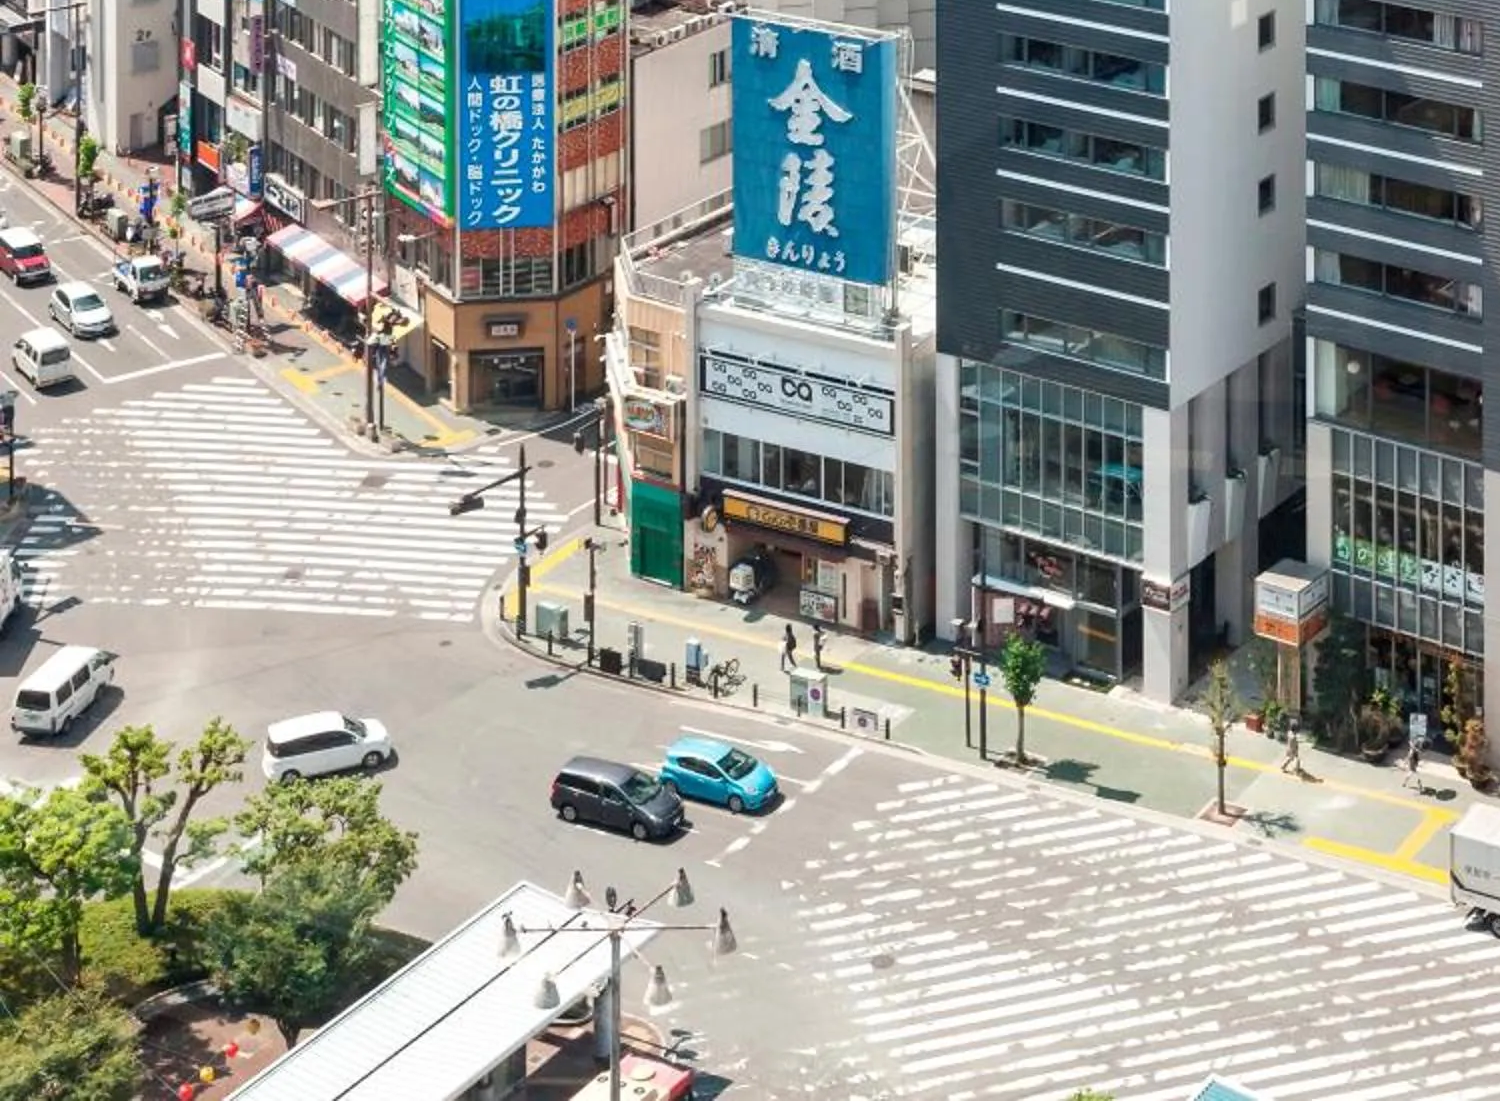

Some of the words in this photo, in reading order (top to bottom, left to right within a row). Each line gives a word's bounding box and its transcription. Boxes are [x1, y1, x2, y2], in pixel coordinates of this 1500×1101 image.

[467, 77, 484, 227] 人間ドック・脳ドック
[489, 75, 525, 225] 虹の橋クリニック
[531, 137, 546, 194] たかがわ
[768, 58, 854, 238] 金陵
